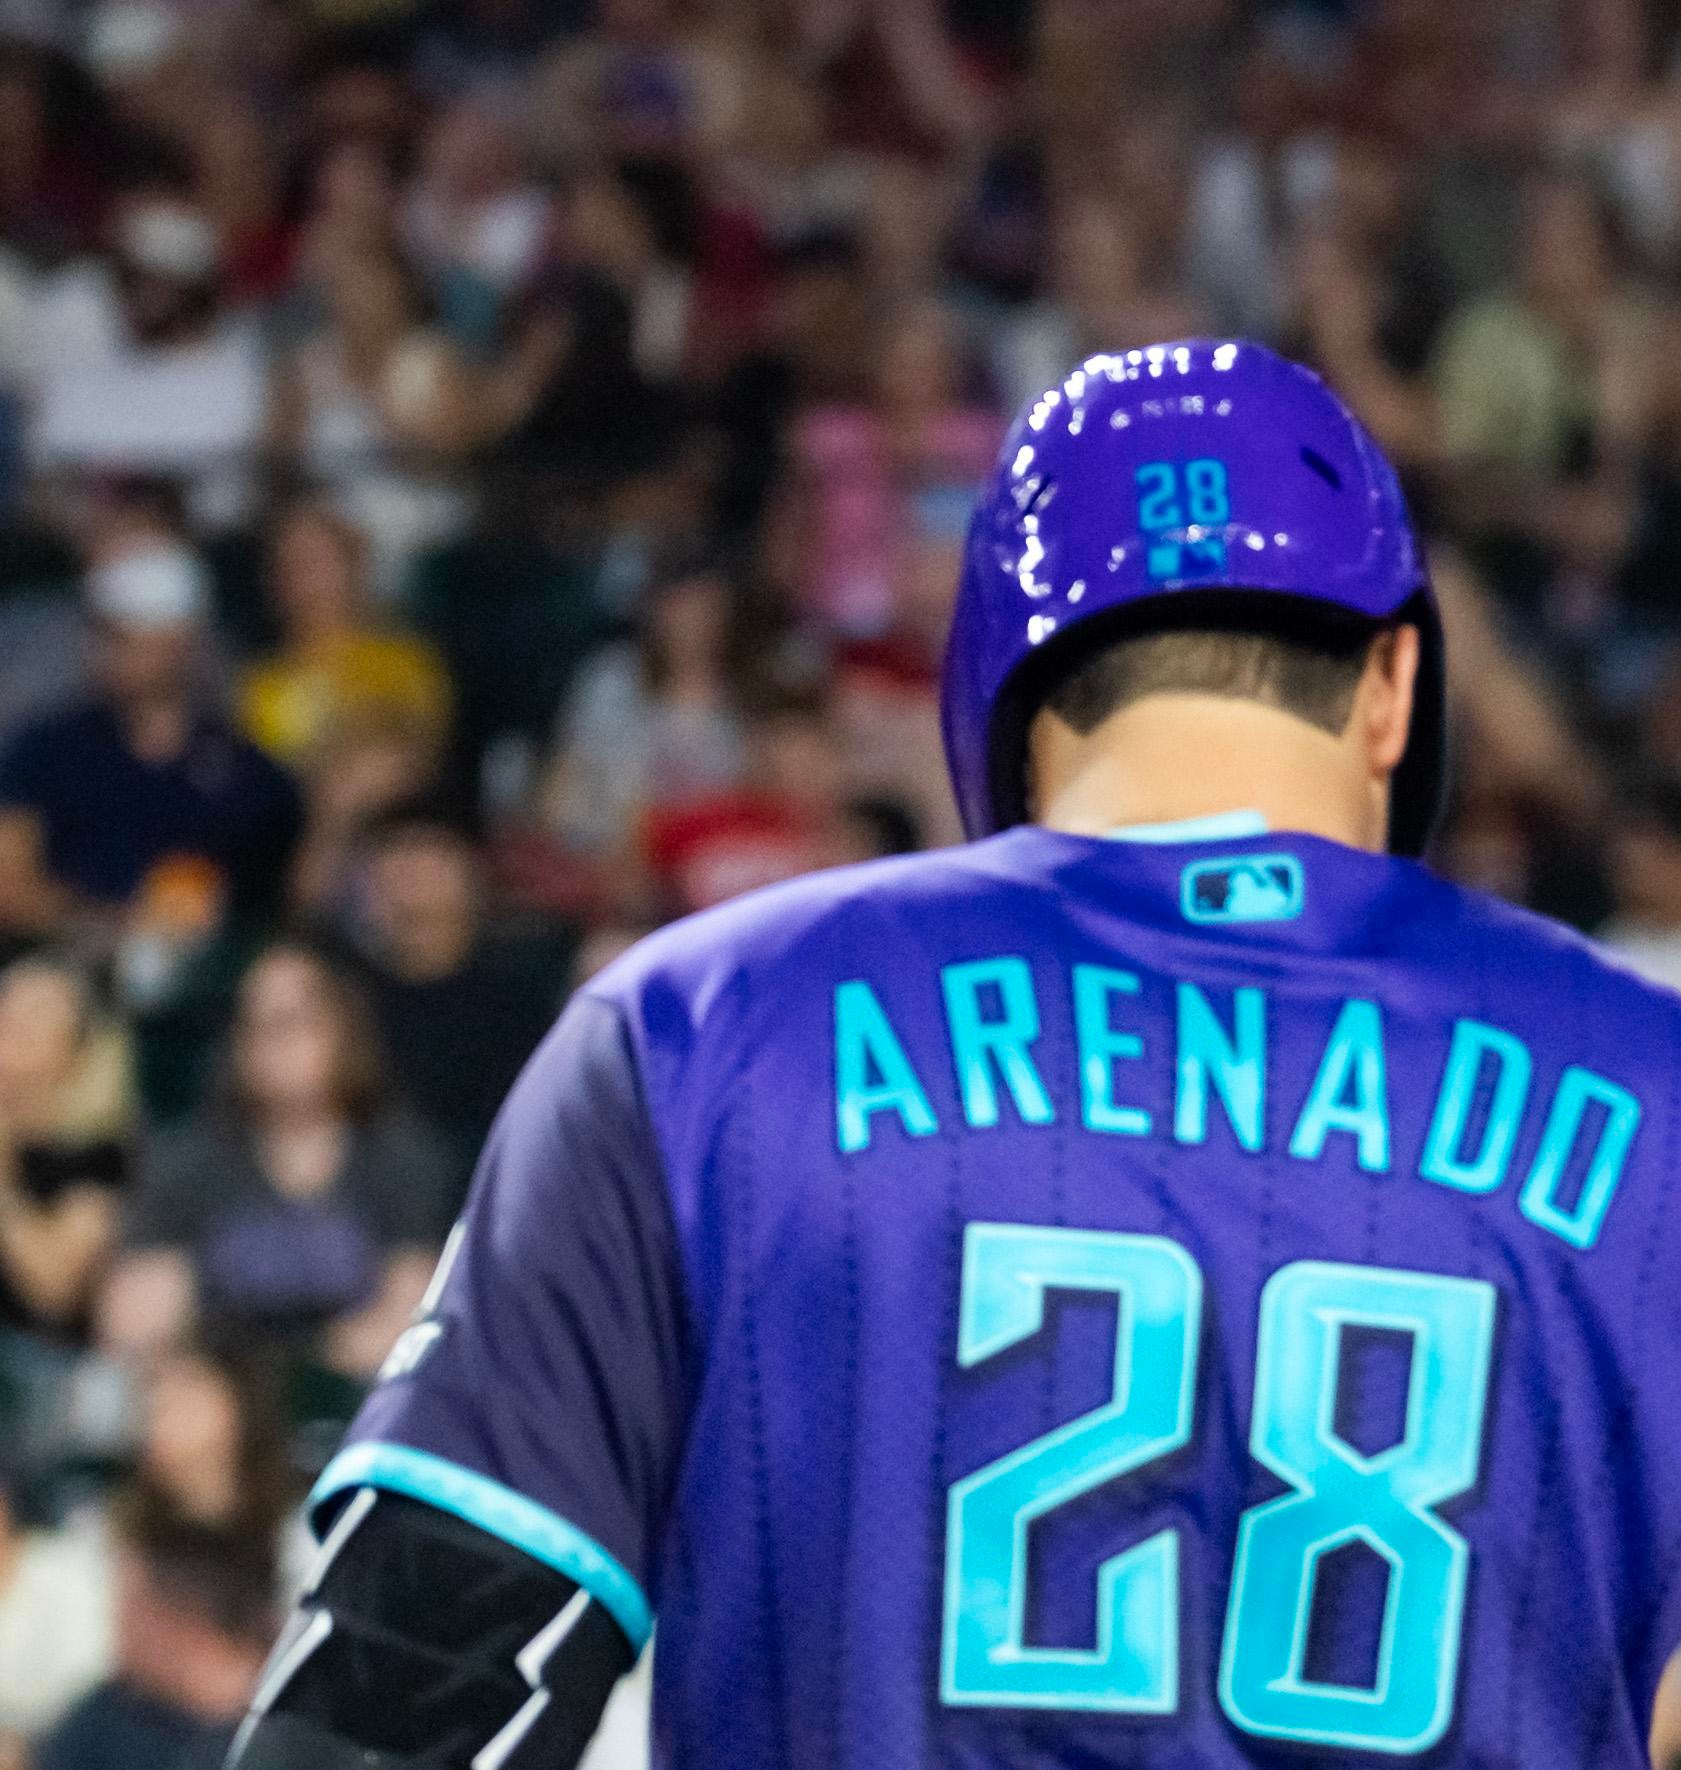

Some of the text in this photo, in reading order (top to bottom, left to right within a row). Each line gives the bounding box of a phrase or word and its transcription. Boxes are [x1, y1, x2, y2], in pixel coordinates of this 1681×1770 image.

[1135, 457, 1229, 530] 28
[833, 955, 1642, 1250] ARENADO
[939, 1222, 1497, 1756] 28
